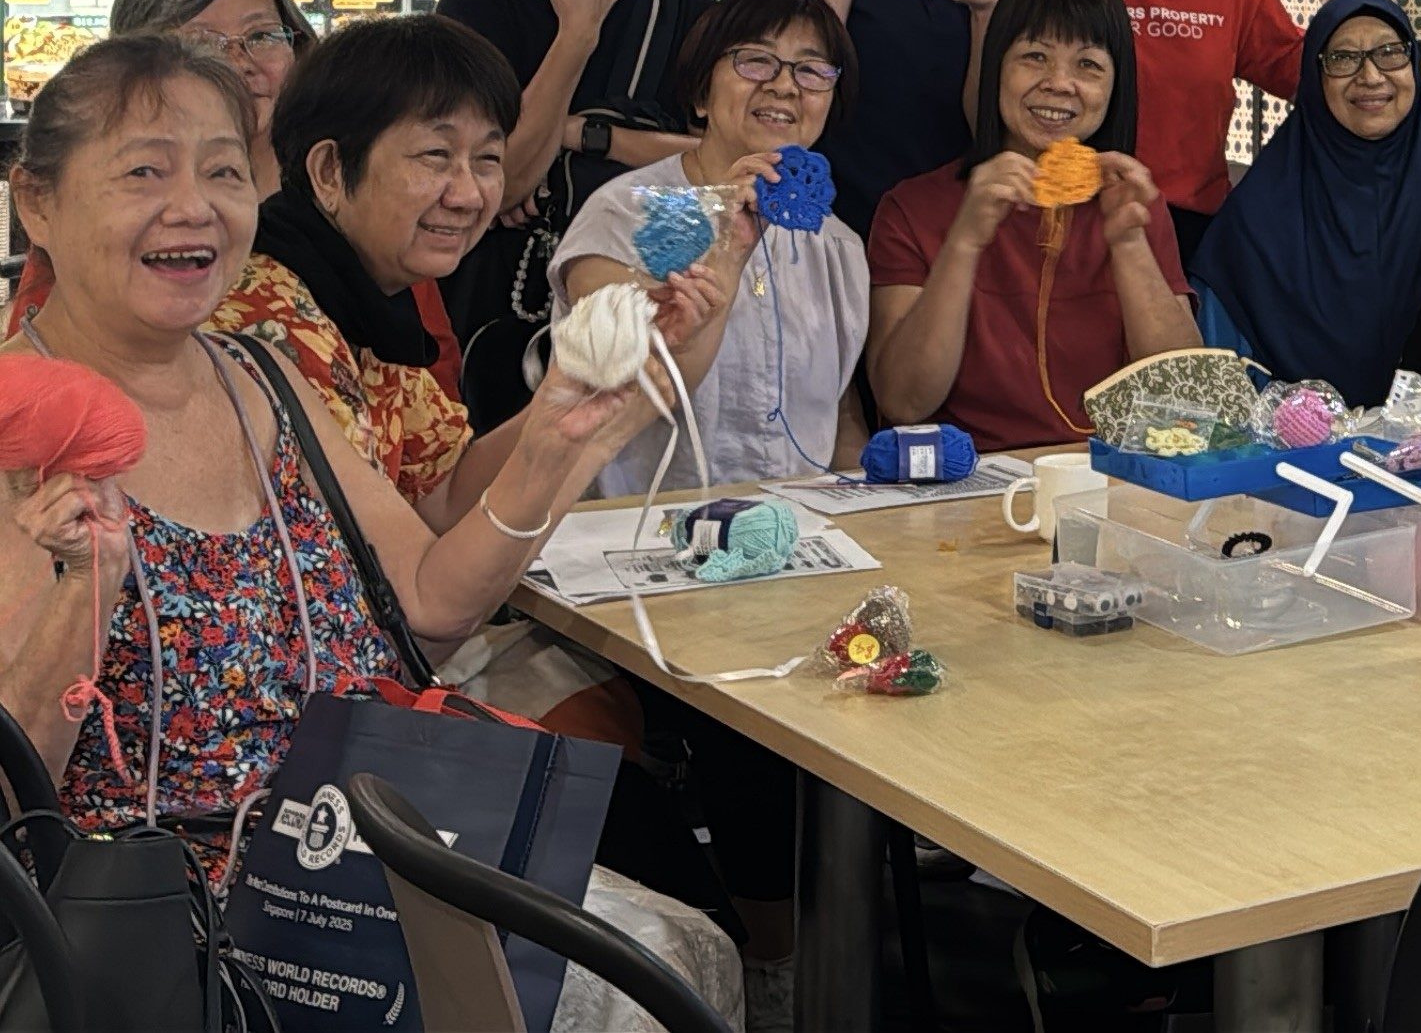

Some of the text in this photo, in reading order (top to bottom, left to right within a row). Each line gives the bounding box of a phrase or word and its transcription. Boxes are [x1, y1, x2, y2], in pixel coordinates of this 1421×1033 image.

[1150, 7, 1225, 27] PROPERTY
[1147, 22, 1204, 40] GOOD
[299, 891, 311, 905] To
[310, 893, 318, 906] A
[320, 895, 363, 915] Postcard
[376, 906, 398, 922] One
[306, 912, 328, 929] July
[329, 916, 353, 932] 2025
[268, 959, 310, 983] WORLD
[288, 986, 340, 1012] HOLDER
